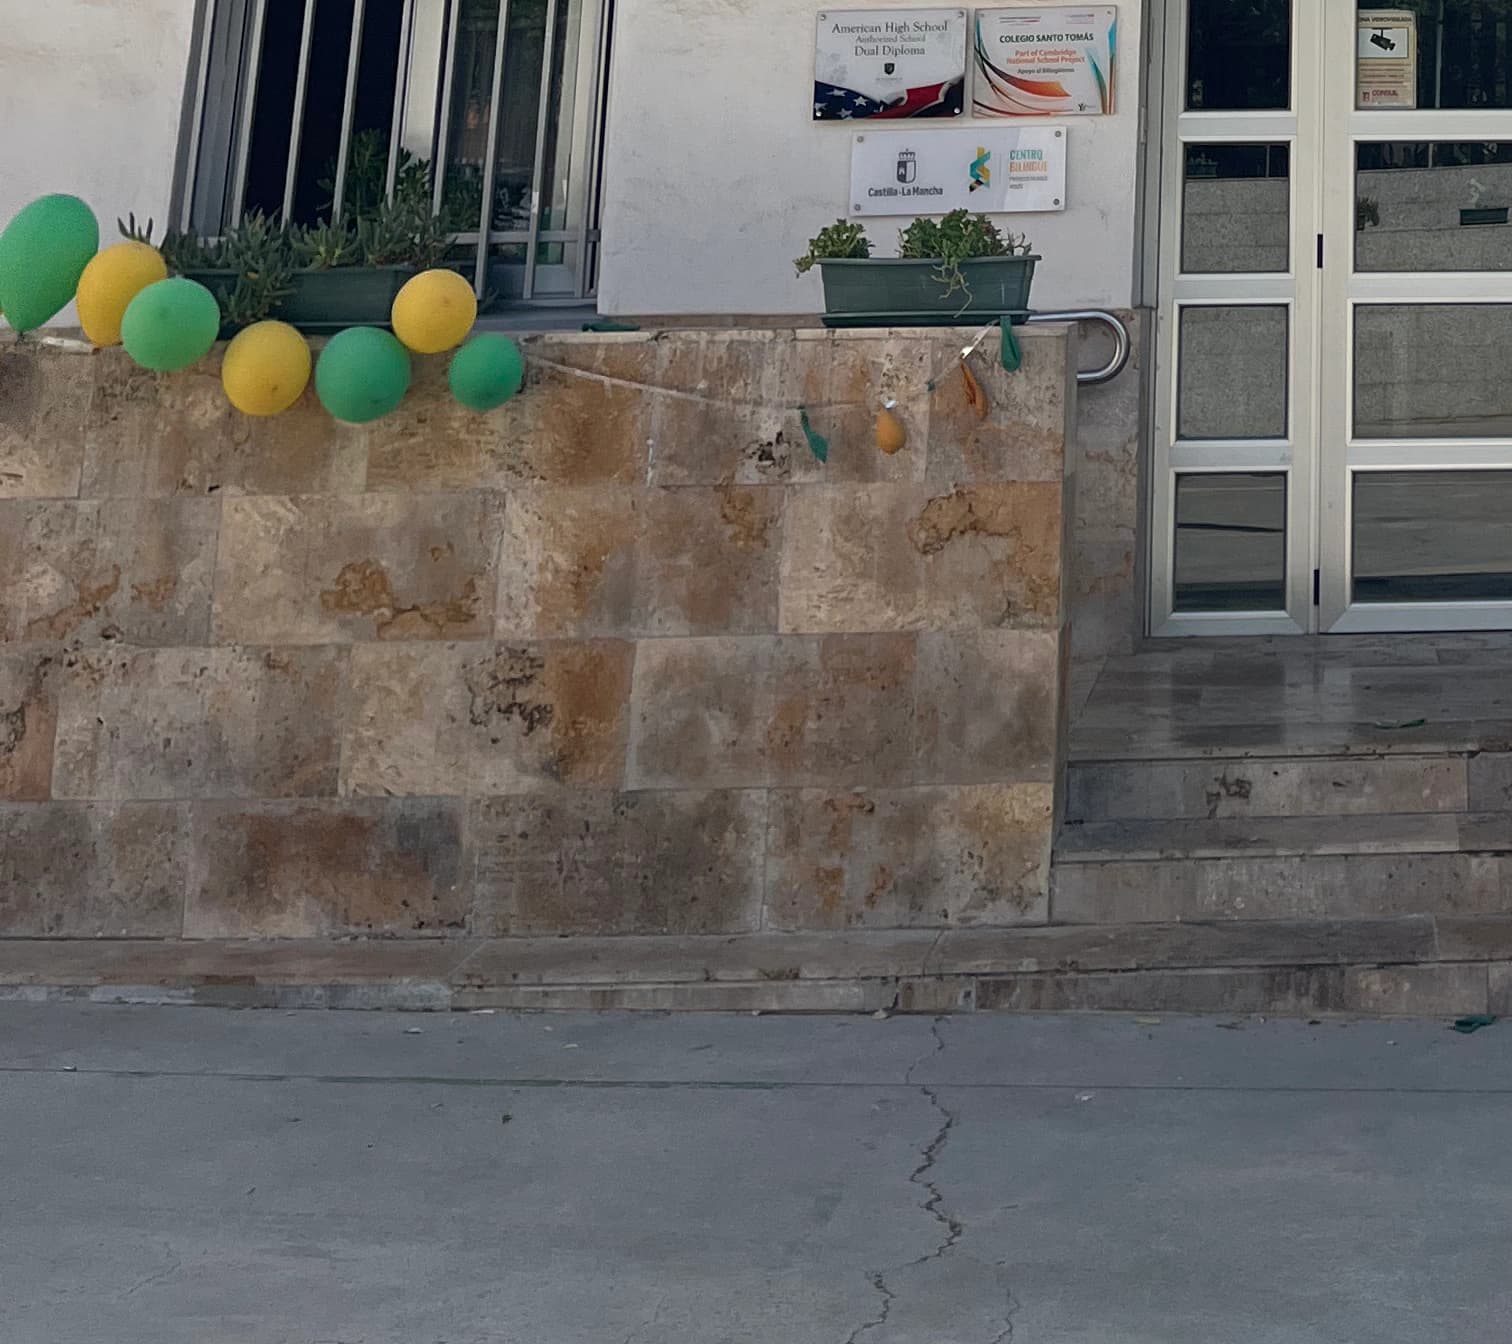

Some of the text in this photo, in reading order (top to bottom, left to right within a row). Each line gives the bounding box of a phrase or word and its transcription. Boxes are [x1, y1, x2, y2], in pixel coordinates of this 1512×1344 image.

[832, 20, 948, 34] American High School
[900, 33, 926, 43] School
[999, 31, 1094, 44] COLEGIO SANTO TOMÁS
[854, 43, 926, 57] Dual Diploma
[1009, 150, 1043, 161] CENTRO
[912, 186, 943, 196] Mancha
